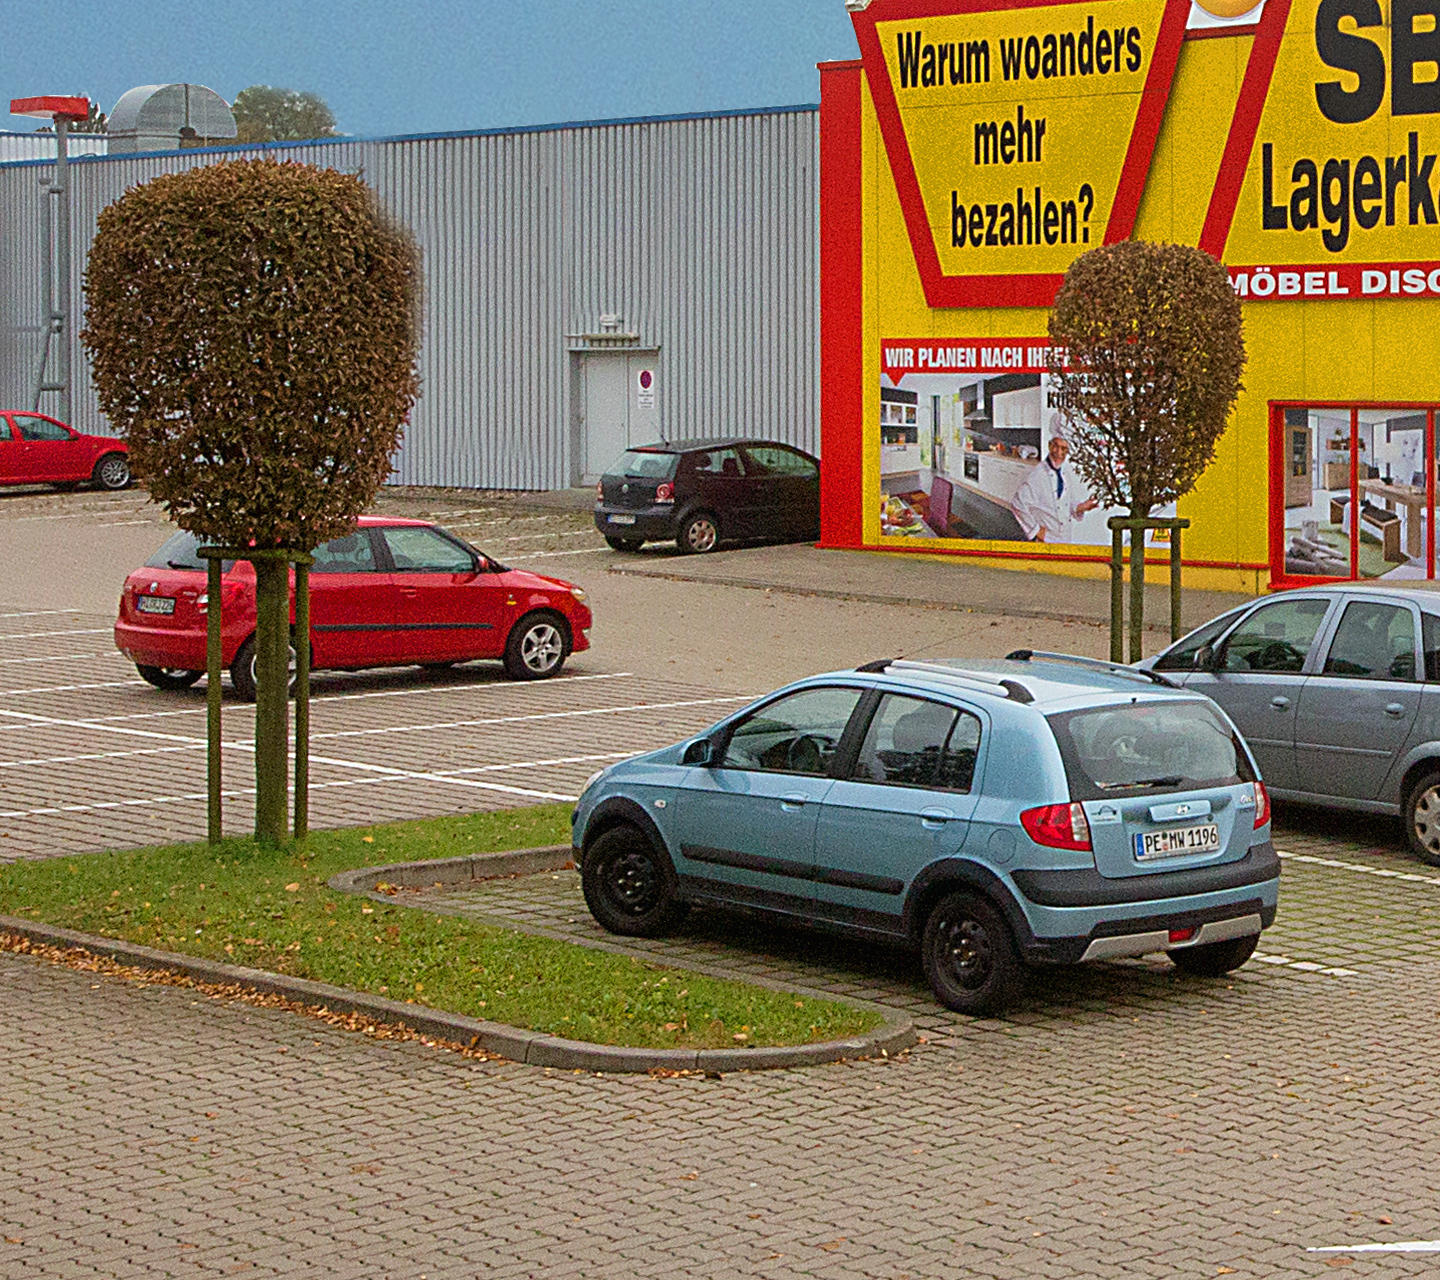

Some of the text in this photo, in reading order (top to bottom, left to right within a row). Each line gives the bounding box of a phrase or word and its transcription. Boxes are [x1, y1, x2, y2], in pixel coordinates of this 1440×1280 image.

[897, 16, 1142, 89] Warum woanders
[974, 105, 1046, 165] mehr
[951, 183, 1094, 247] bezahlen?
[1227, 267, 1349, 297] MÖBEL
[885, 348, 914, 368] WIR
[918, 347, 976, 368] PLANEN
[981, 346, 1022, 368] NACH
[1145, 826, 1218, 853] PE MW 1196
